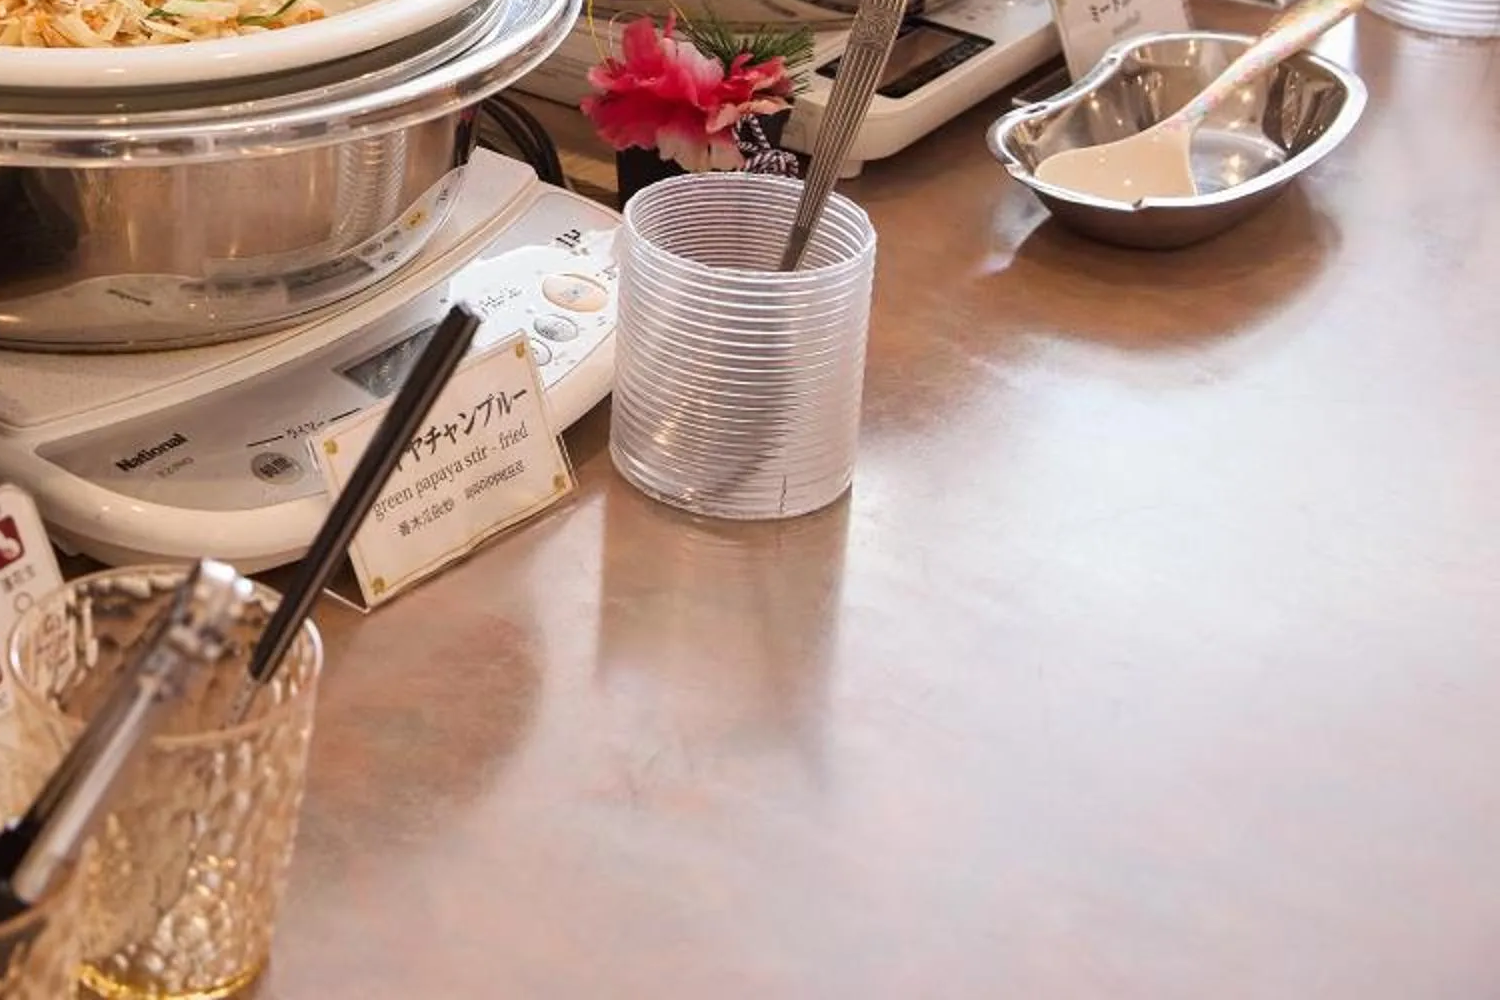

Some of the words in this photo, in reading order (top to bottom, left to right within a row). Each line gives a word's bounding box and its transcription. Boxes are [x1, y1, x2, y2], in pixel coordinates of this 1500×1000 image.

[116, 432, 188, 472] National
[372, 487, 413, 522] green
[415, 460, 464, 498] papaya
[499, 420, 529, 451] fried
